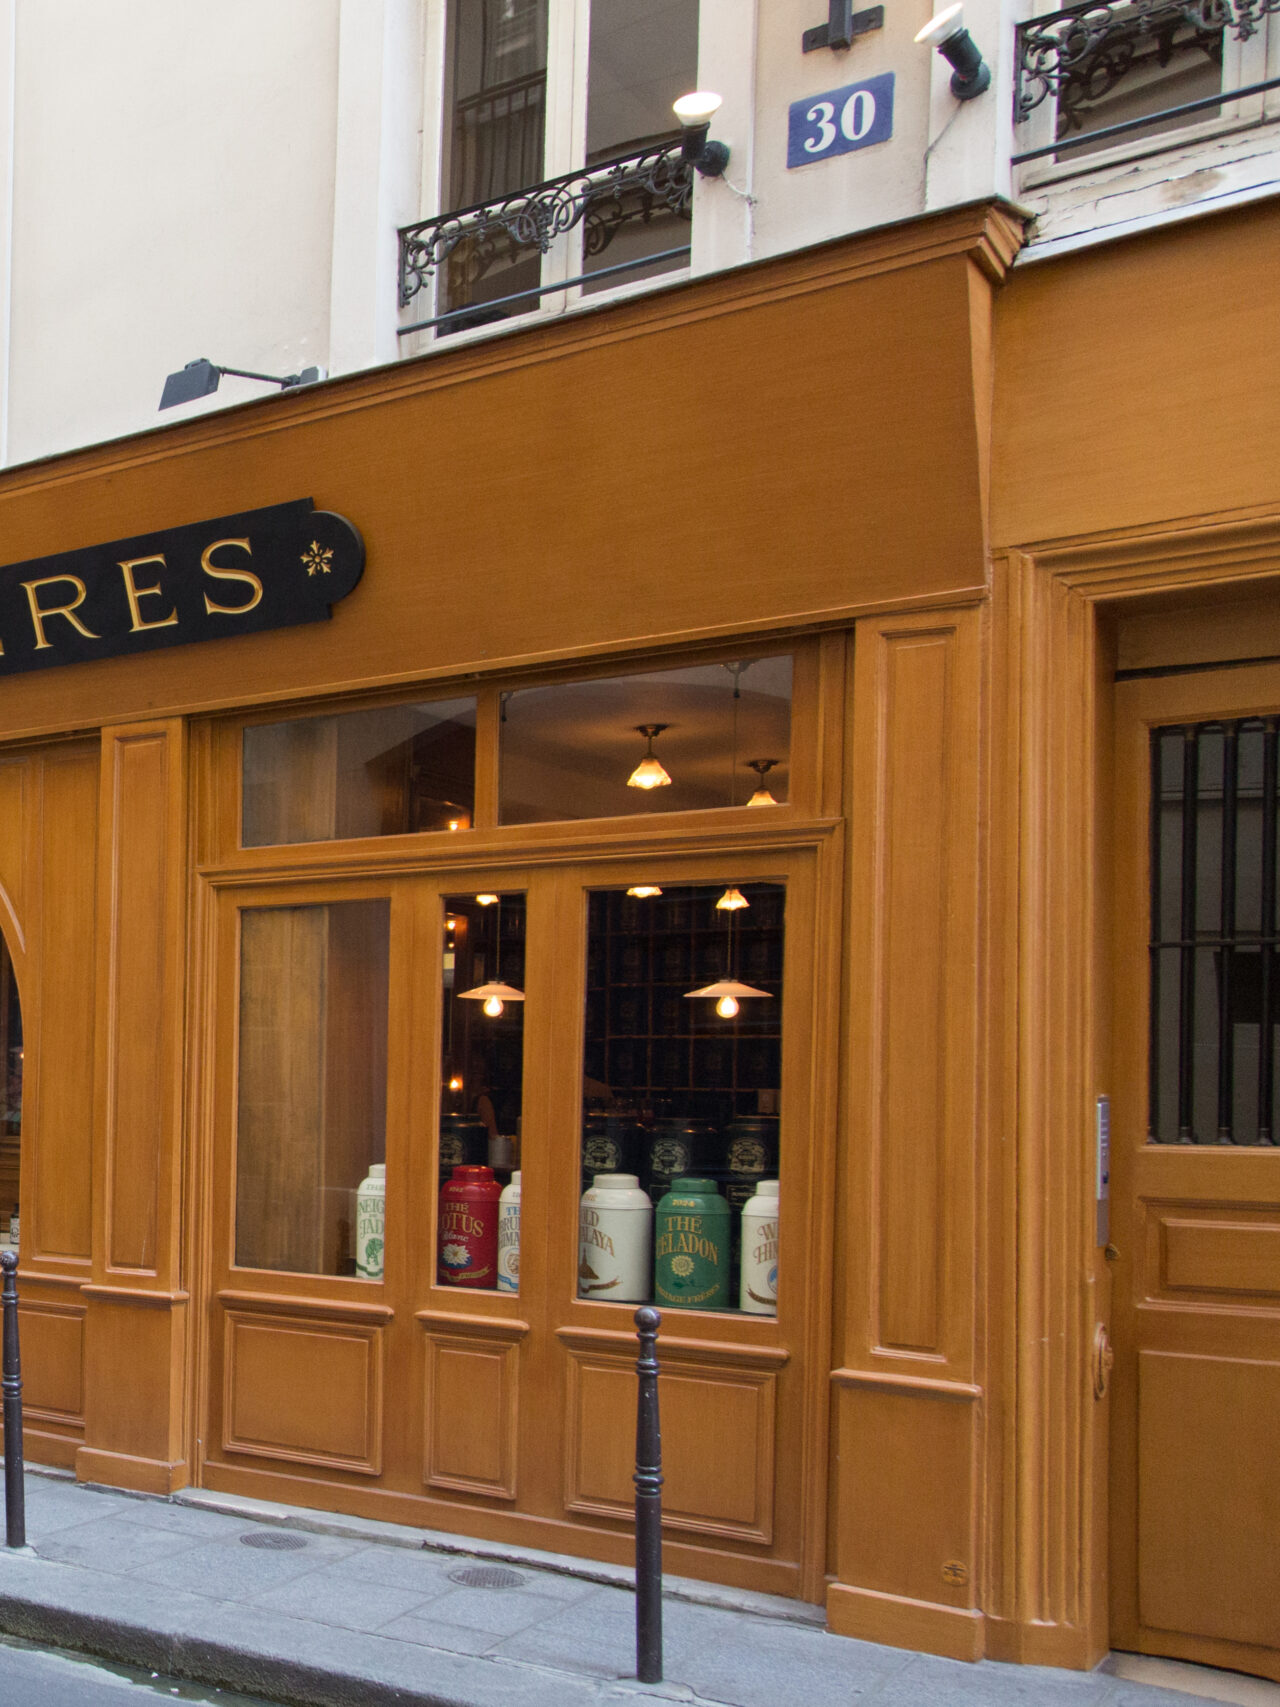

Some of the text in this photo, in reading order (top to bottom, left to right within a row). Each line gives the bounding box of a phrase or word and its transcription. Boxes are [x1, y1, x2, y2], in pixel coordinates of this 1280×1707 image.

[804, 90, 875, 153] 30
[441, 1212, 484, 1238] OTUS
[664, 1215, 703, 1235] THÉ
